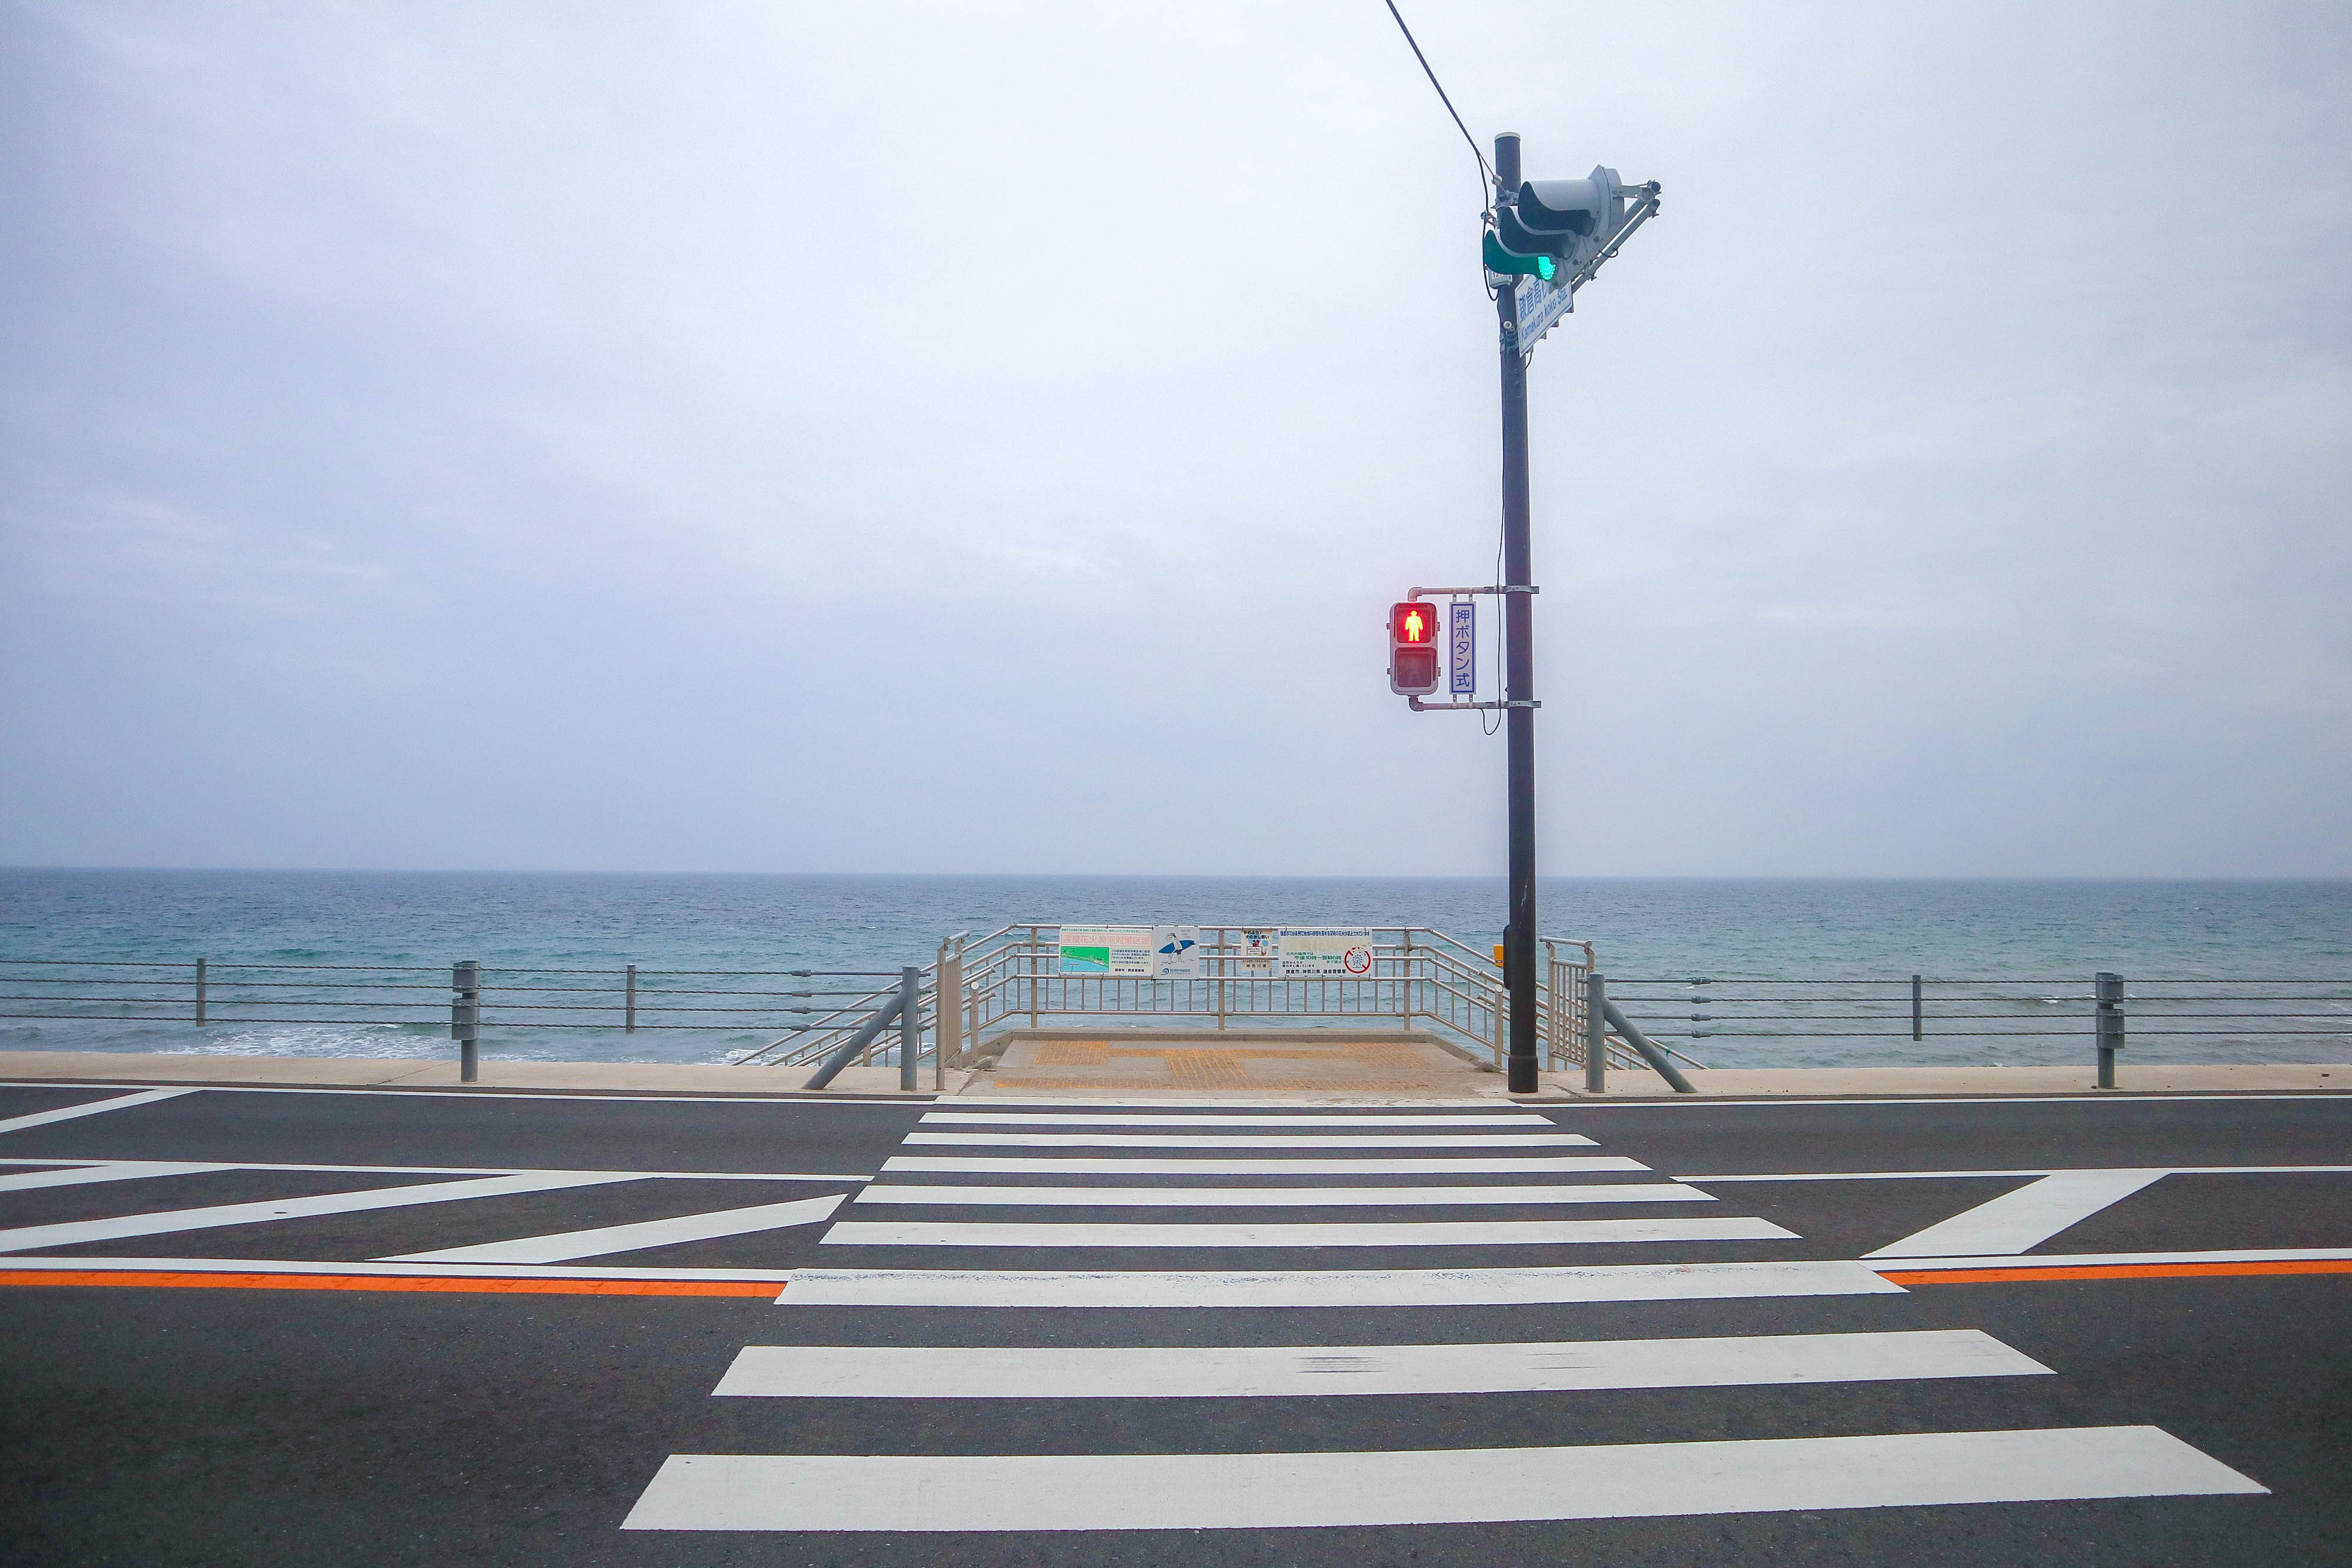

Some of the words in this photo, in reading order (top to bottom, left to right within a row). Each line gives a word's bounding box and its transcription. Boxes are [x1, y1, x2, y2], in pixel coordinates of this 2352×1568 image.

[1521, 312, 1544, 341] Kamakura
[1557, 288, 1568, 305] Sta.
[1456, 609, 1470, 687] 押ボタン式
